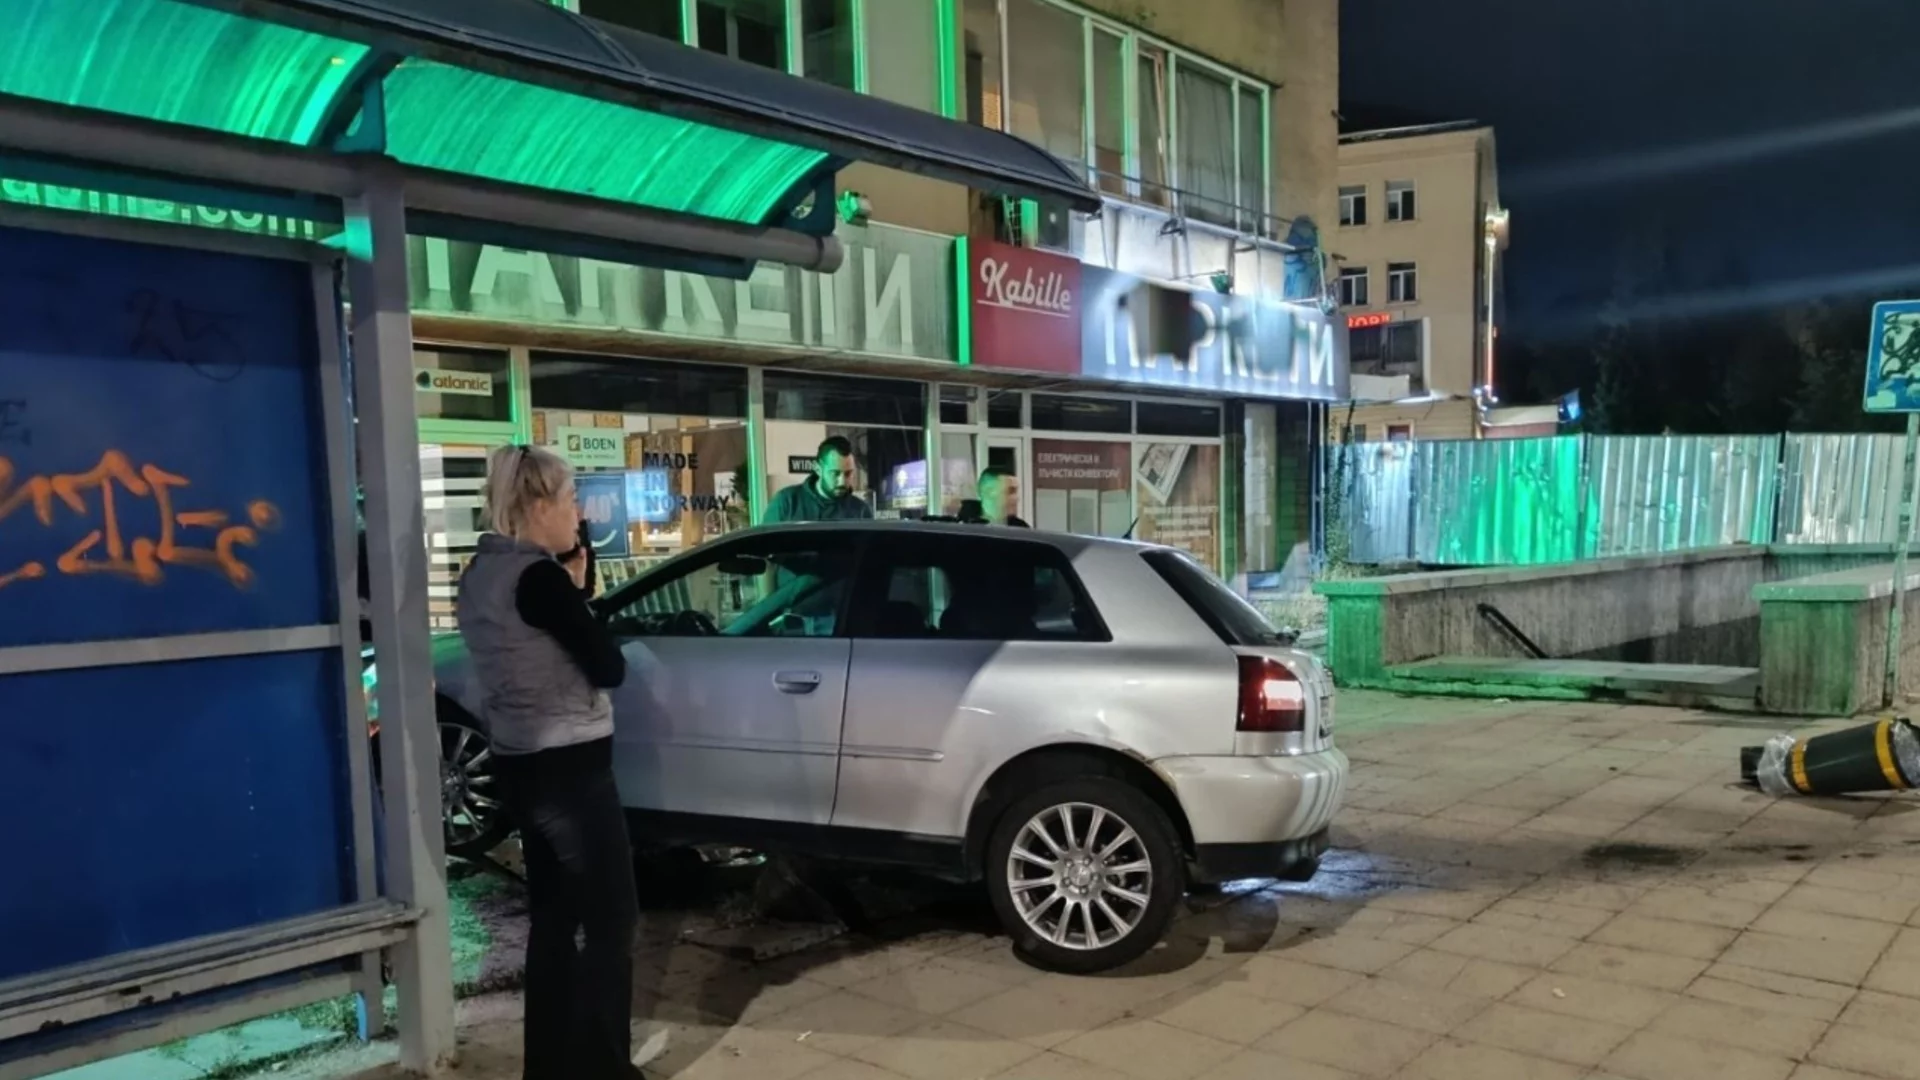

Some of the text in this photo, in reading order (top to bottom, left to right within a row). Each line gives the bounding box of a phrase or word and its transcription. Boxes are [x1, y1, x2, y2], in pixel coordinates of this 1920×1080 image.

[979, 256, 1072, 309] Kabille
[433, 376, 489, 391] atlantic
[583, 437, 616, 449] BOEN
[643, 452, 699, 468] MADE
[644, 474, 666, 491] IN
[644, 496, 730, 513] NORWAY
